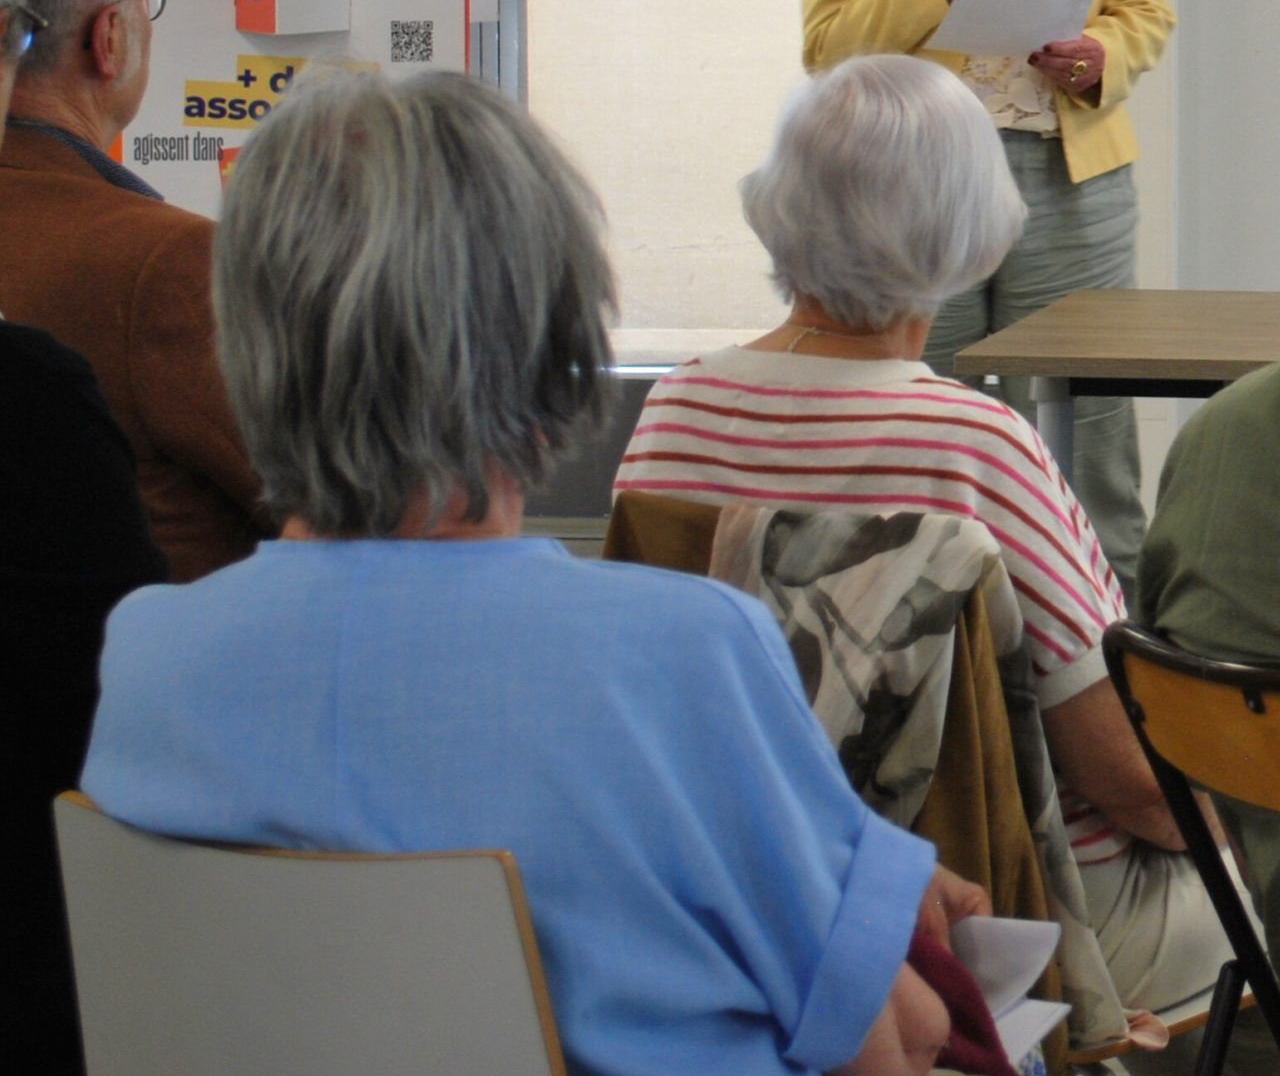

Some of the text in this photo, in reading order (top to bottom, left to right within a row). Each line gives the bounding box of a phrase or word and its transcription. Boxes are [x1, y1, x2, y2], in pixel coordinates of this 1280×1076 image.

[184, 95, 272, 121] asso
[133, 131, 224, 165] agissent dans
